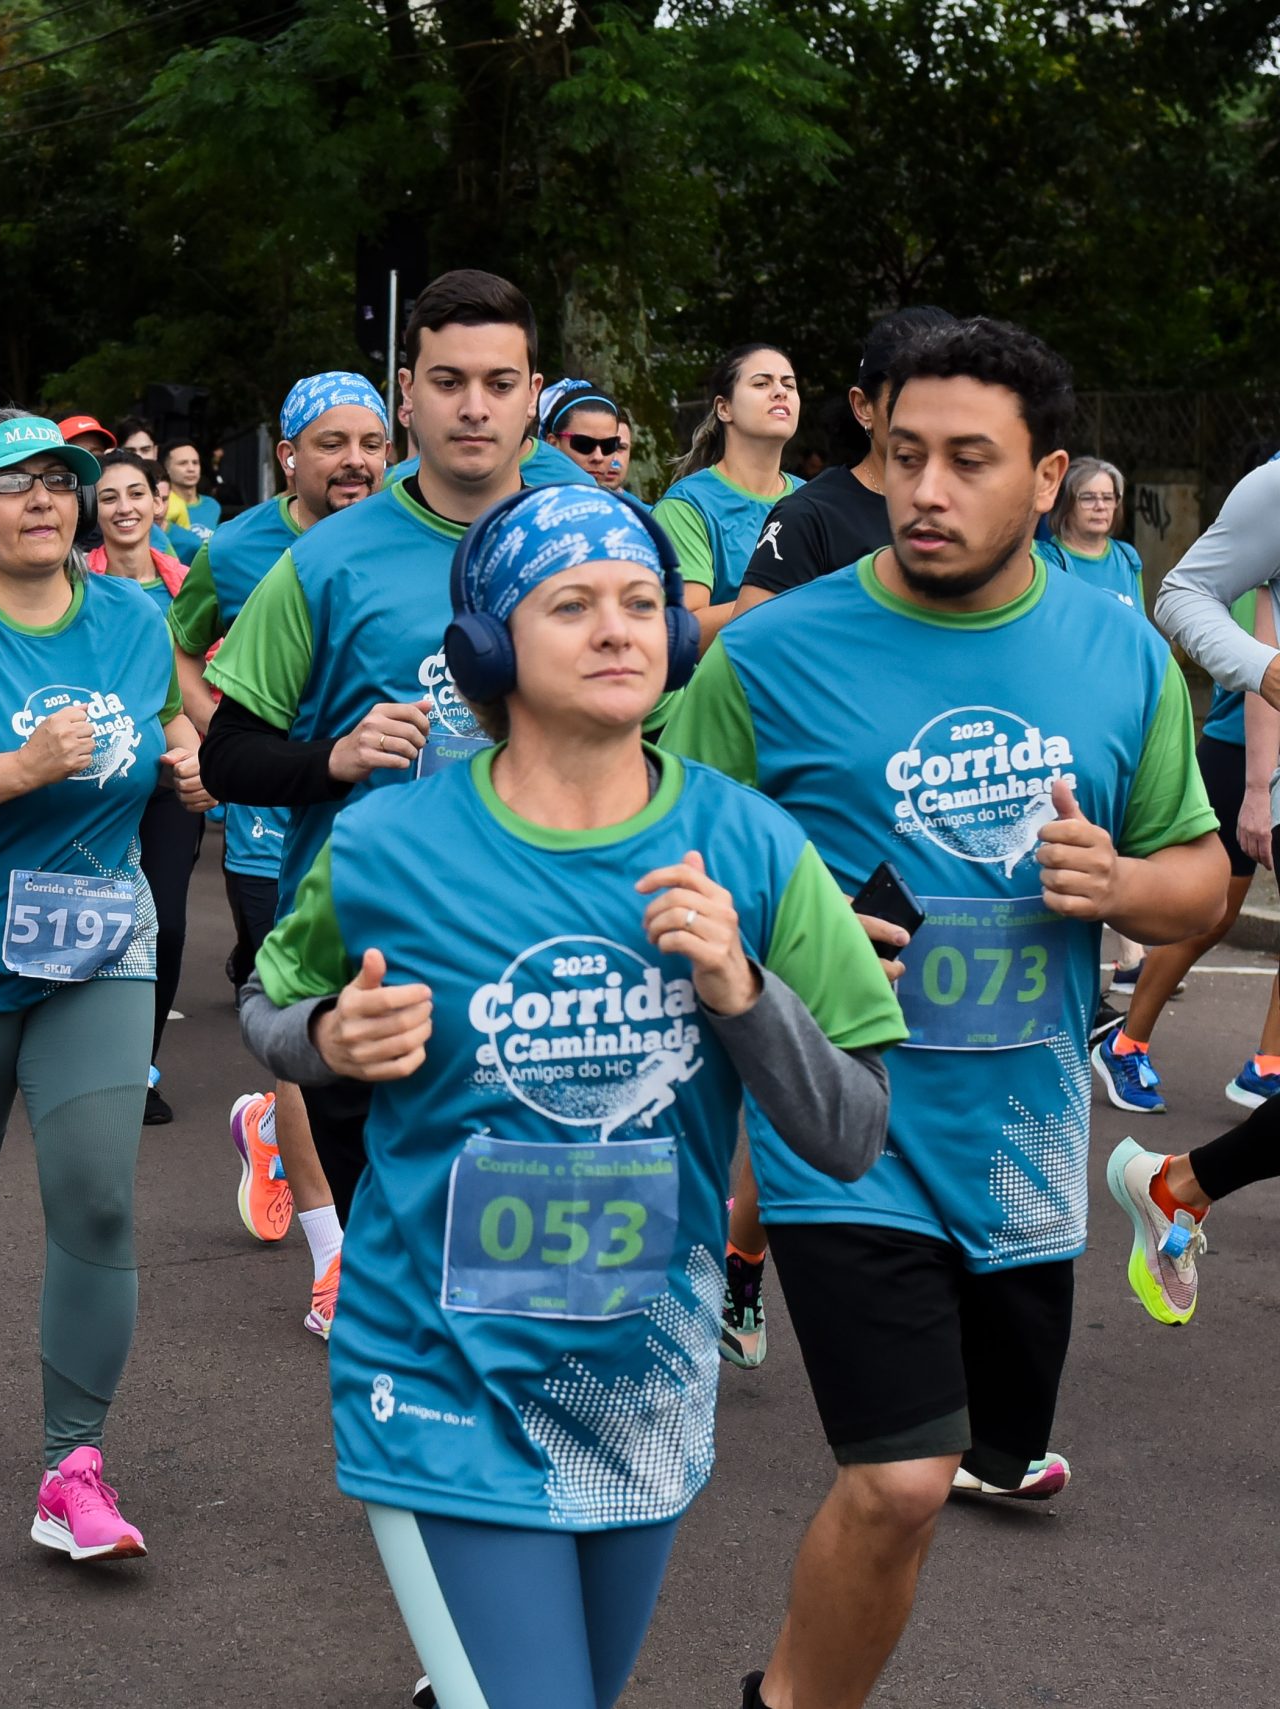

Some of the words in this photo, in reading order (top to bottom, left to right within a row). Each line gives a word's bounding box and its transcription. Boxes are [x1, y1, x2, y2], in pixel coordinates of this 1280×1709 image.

[44, 694, 70, 708] 2023
[426, 709, 439, 719] os
[441, 705, 472, 718] Amig
[950, 720, 995, 741] 2023
[885, 728, 1073, 791] Corrida
[894, 800, 911, 818] e
[894, 819, 920, 834] dos
[923, 812, 976, 829] Amigos
[977, 807, 996, 822] do
[998, 804, 1020, 818] HC
[25, 882, 65, 894] Corrida
[76, 887, 133, 900] Caminhada
[10, 904, 132, 950] 5197
[923, 912, 977, 927] orrida
[982, 918, 992, 927] e
[43, 964, 72, 975] 5KM
[553, 955, 607, 977] 2023
[922, 945, 1048, 1006] 073
[468, 967, 697, 1034] Corrida
[475, 1043, 496, 1065] e
[504, 1019, 700, 1063] Caminhada
[473, 1067, 506, 1084] dos
[509, 1064, 574, 1084] Amigos
[578, 1060, 601, 1077] do
[605, 1059, 632, 1076] HC
[476, 1156, 550, 1175] Corrida
[554, 1165, 565, 1175] e
[572, 1159, 673, 1177] Caminhada
[479, 1195, 648, 1267] 053
[398, 1402, 441, 1421] Amigos
[442, 1412, 460, 1425] do
